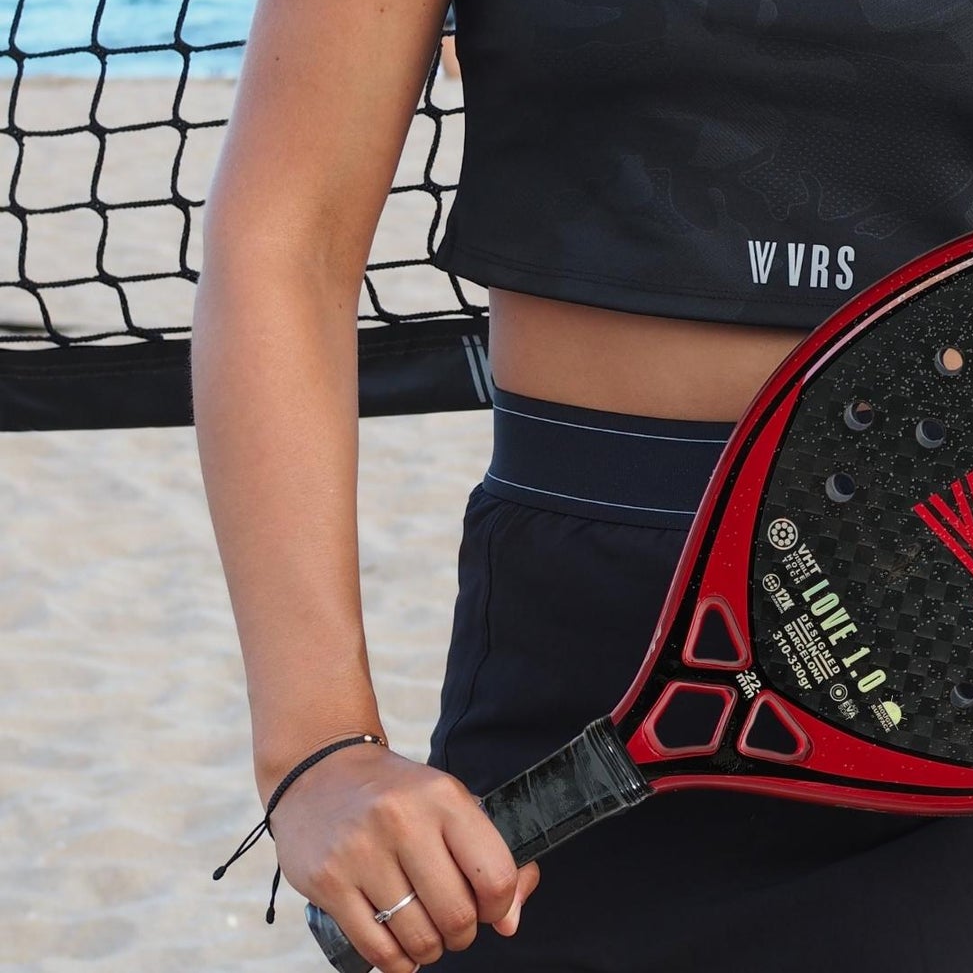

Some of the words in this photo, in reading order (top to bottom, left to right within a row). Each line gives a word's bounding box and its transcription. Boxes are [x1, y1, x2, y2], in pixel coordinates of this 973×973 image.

[787, 242, 855, 290] VRS
[781, 556, 801, 585] TECH
[786, 553, 806, 582] HOLE
[792, 550, 811, 578] VISIBLE
[797, 542, 822, 574] VHT
[774, 587, 795, 612] 12K
[799, 613, 841, 674] DESIGNED
[801, 578, 858, 647] LOVE
[841, 646, 887, 693] 1.0
[805, 641, 820, 657] IN
[772, 630, 813, 690] 310-330gr
[783, 623, 824, 685] BARCELONA
[735, 672, 755, 699] mm
[842, 700, 856, 719] EVA
[870, 704, 891, 733] SURFACE
[877, 704, 894, 728] ROUGH
